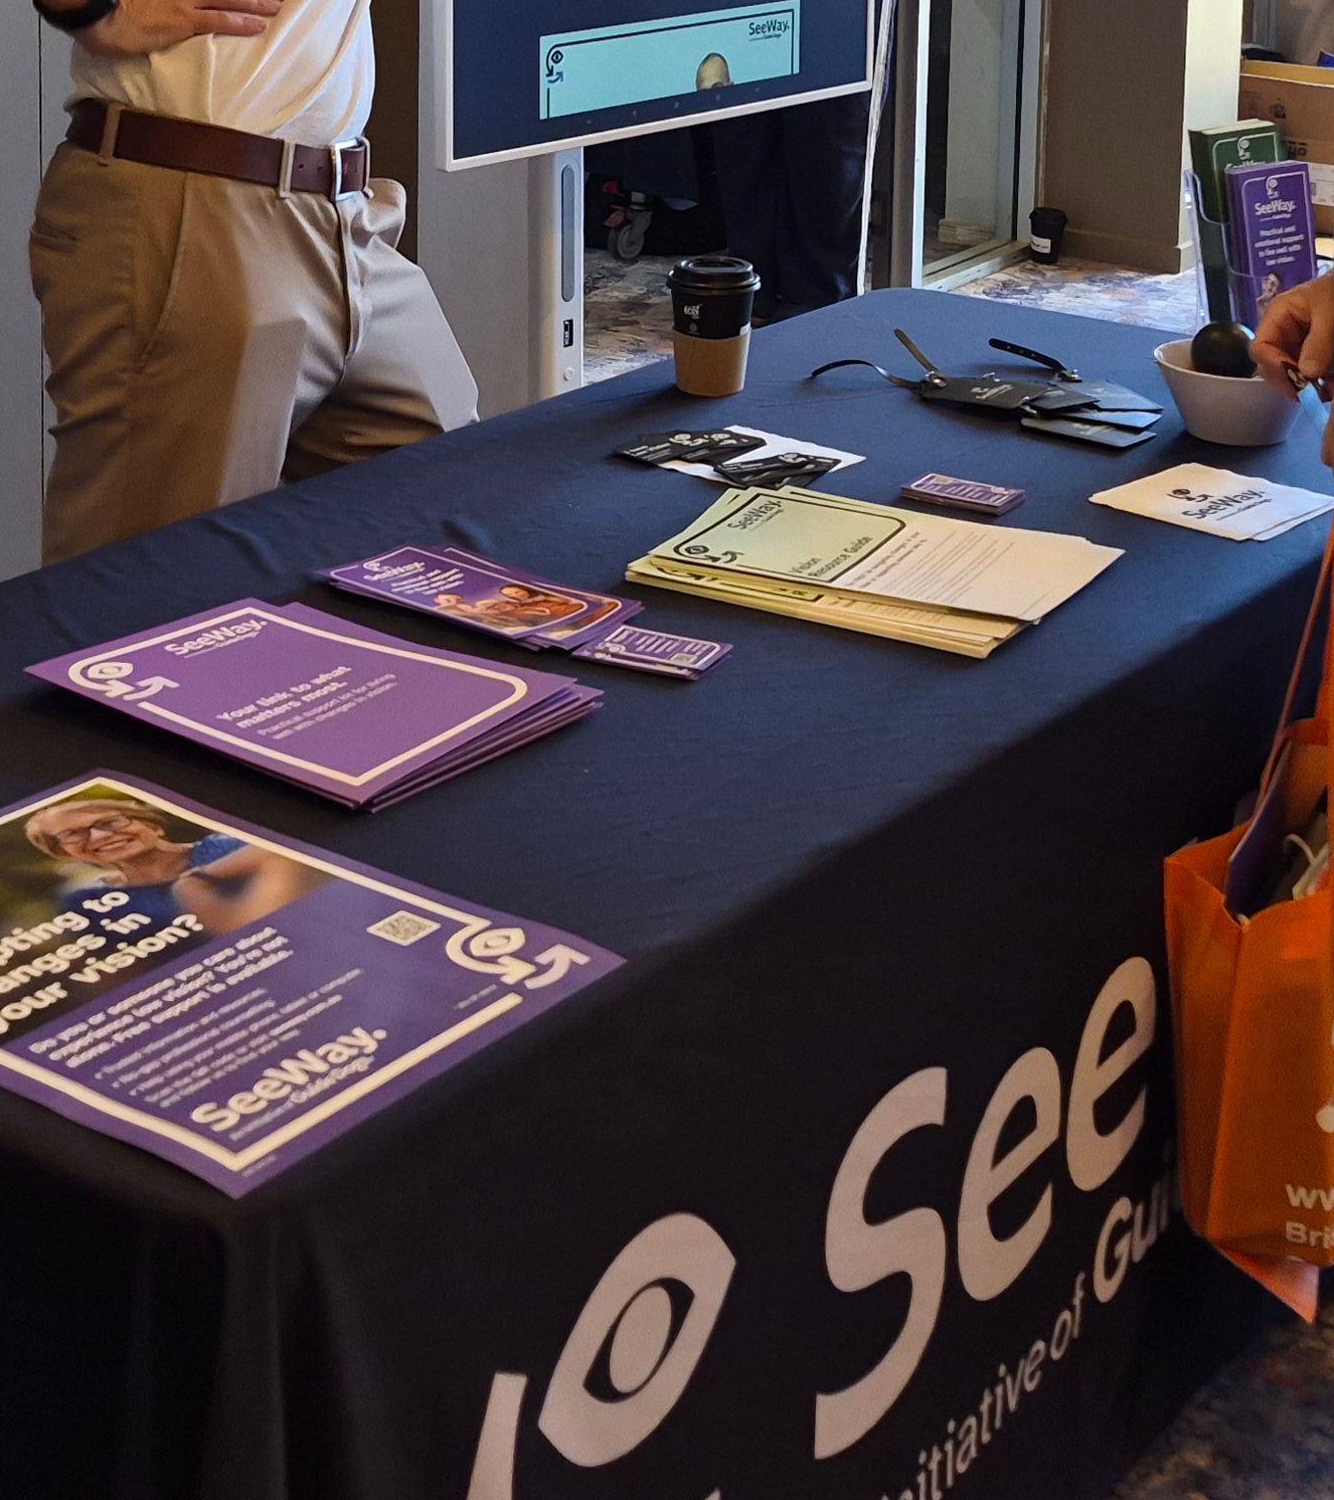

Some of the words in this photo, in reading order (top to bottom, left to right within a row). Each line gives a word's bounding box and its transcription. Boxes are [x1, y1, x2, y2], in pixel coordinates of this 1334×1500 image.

[748, 18, 790, 36] SeeWay.
[1181, 489, 1267, 520] SeeWay.
[164, 618, 268, 655] SeeWay.
[82, 891, 131, 913] to
[99, 912, 153, 935] in
[69, 913, 205, 985] vision?
[190, 1026, 387, 1132] SeeWay.
[1050, 1271, 1087, 1361] of
